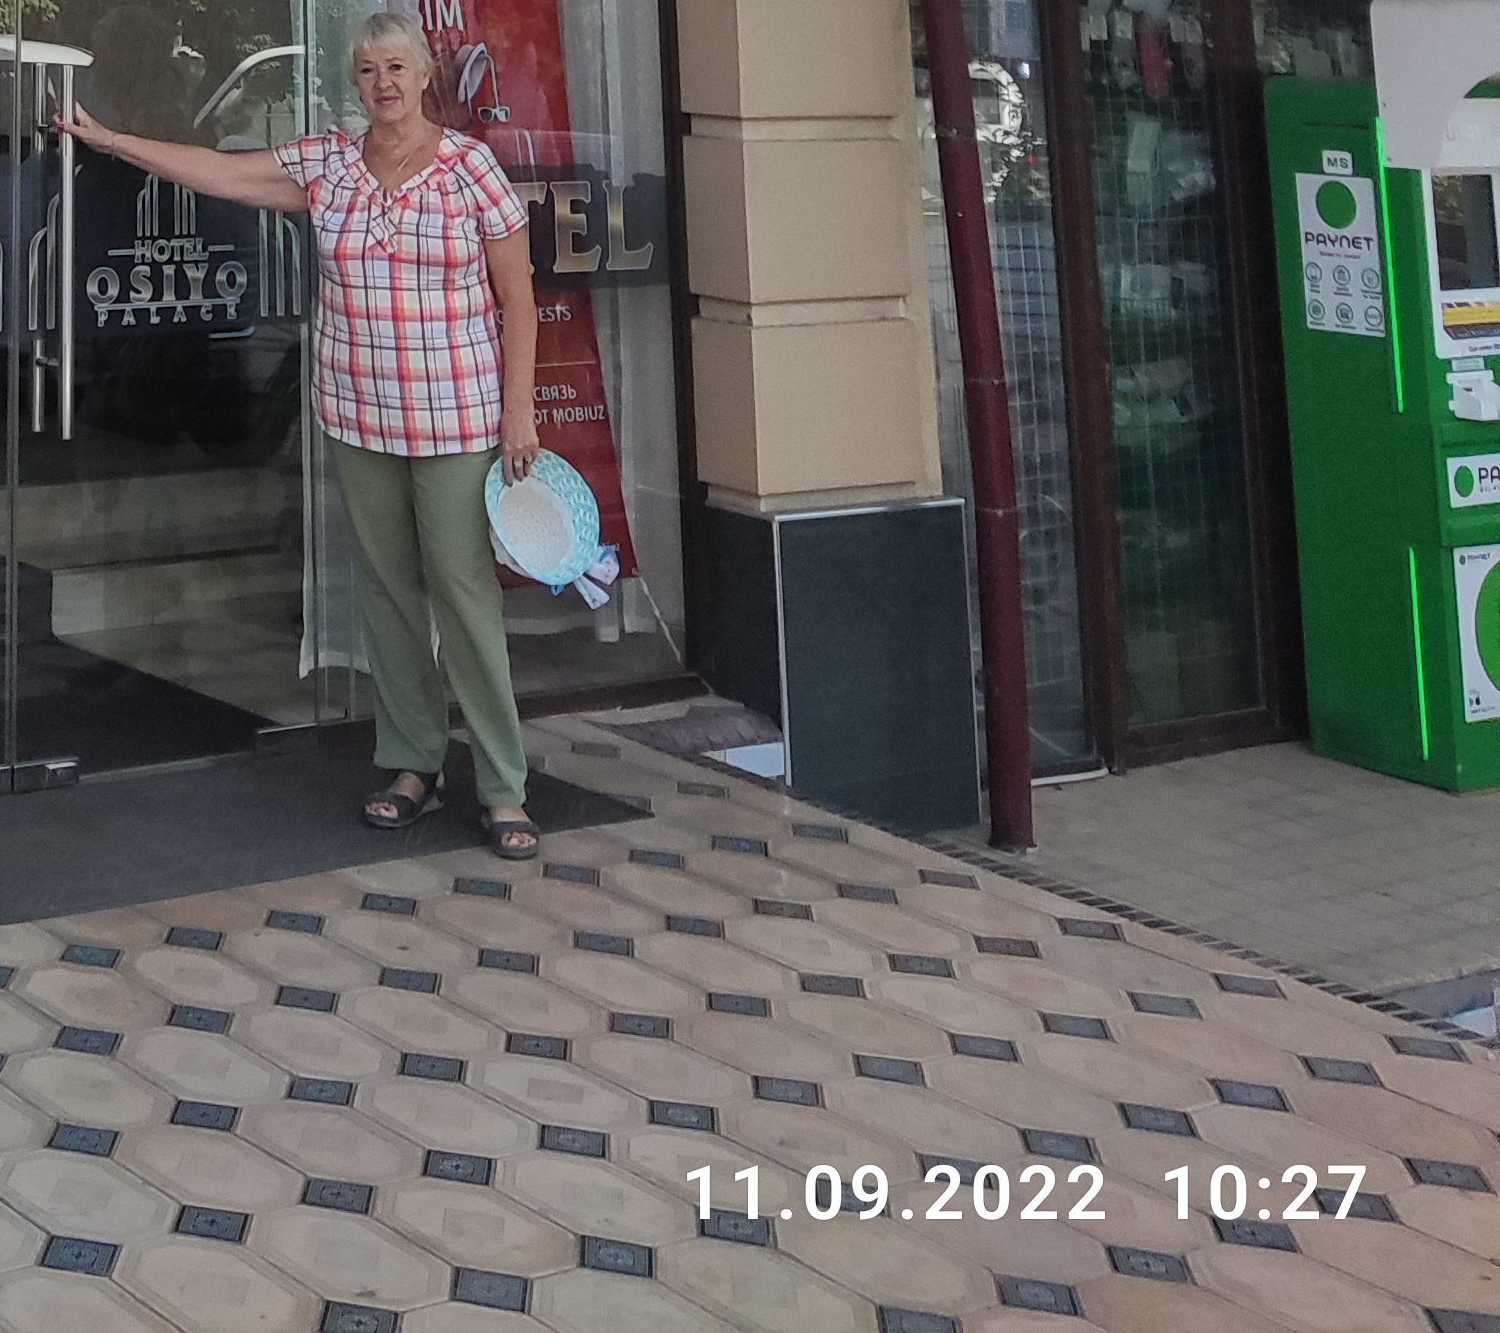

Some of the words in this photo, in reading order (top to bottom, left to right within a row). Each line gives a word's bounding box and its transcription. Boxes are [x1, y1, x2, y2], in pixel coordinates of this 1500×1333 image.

[1326, 156, 1349, 169] MS
[134, 237, 209, 263] HOTEL
[1304, 231, 1374, 251] PAYNET
[86, 260, 248, 306] OSIYO
[97, 303, 237, 327] PALACE
[552, 405, 606, 424] MOBIUZ
